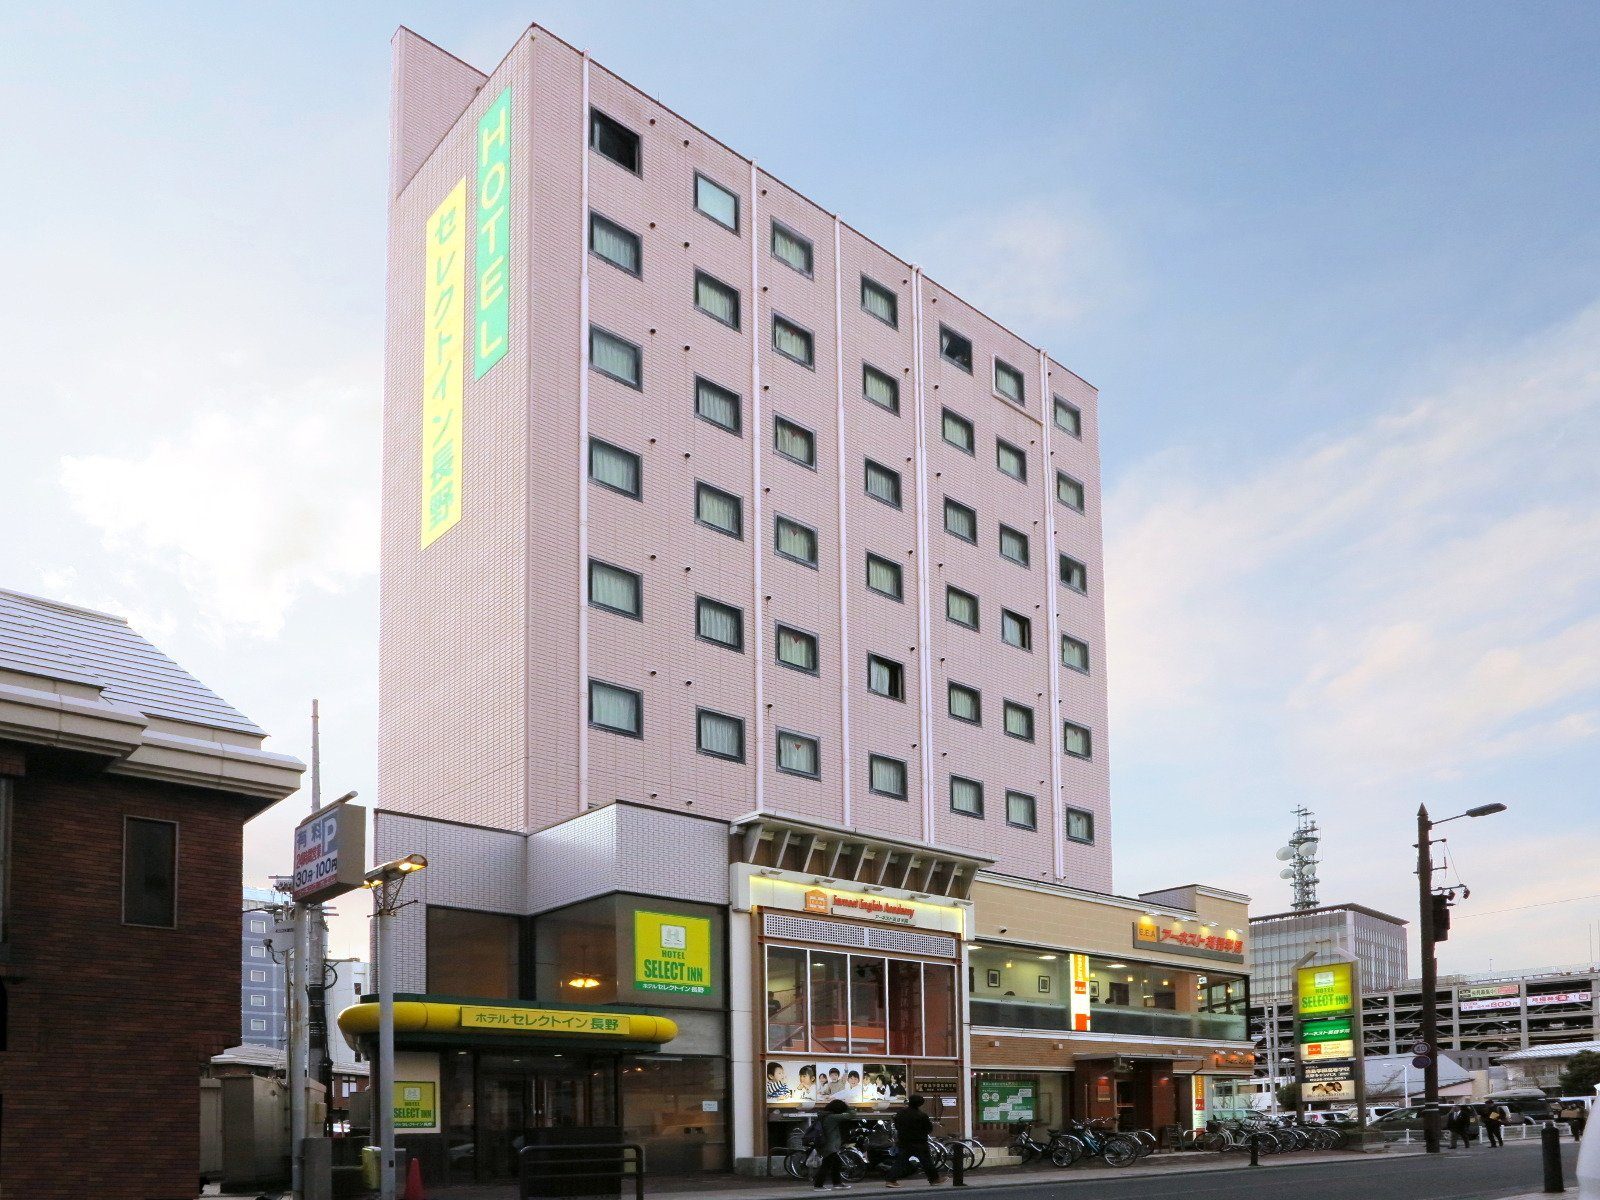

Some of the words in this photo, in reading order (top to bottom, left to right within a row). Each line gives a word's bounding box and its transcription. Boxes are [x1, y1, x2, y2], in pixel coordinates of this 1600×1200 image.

[480, 106, 506, 360] HOTEL
[323, 818, 337, 853] P
[661, 950, 686, 960] HOTEL
[643, 959, 686, 981] SELECT
[687, 966, 703, 982] INN
[1302, 994, 1335, 1008] SELECT
[1336, 995, 1349, 1005] INN
[475, 1012, 620, 1032] ホテルセレクトイン長野
[393, 1107, 420, 1119] SELECT
[420, 1109, 432, 1118] INN
